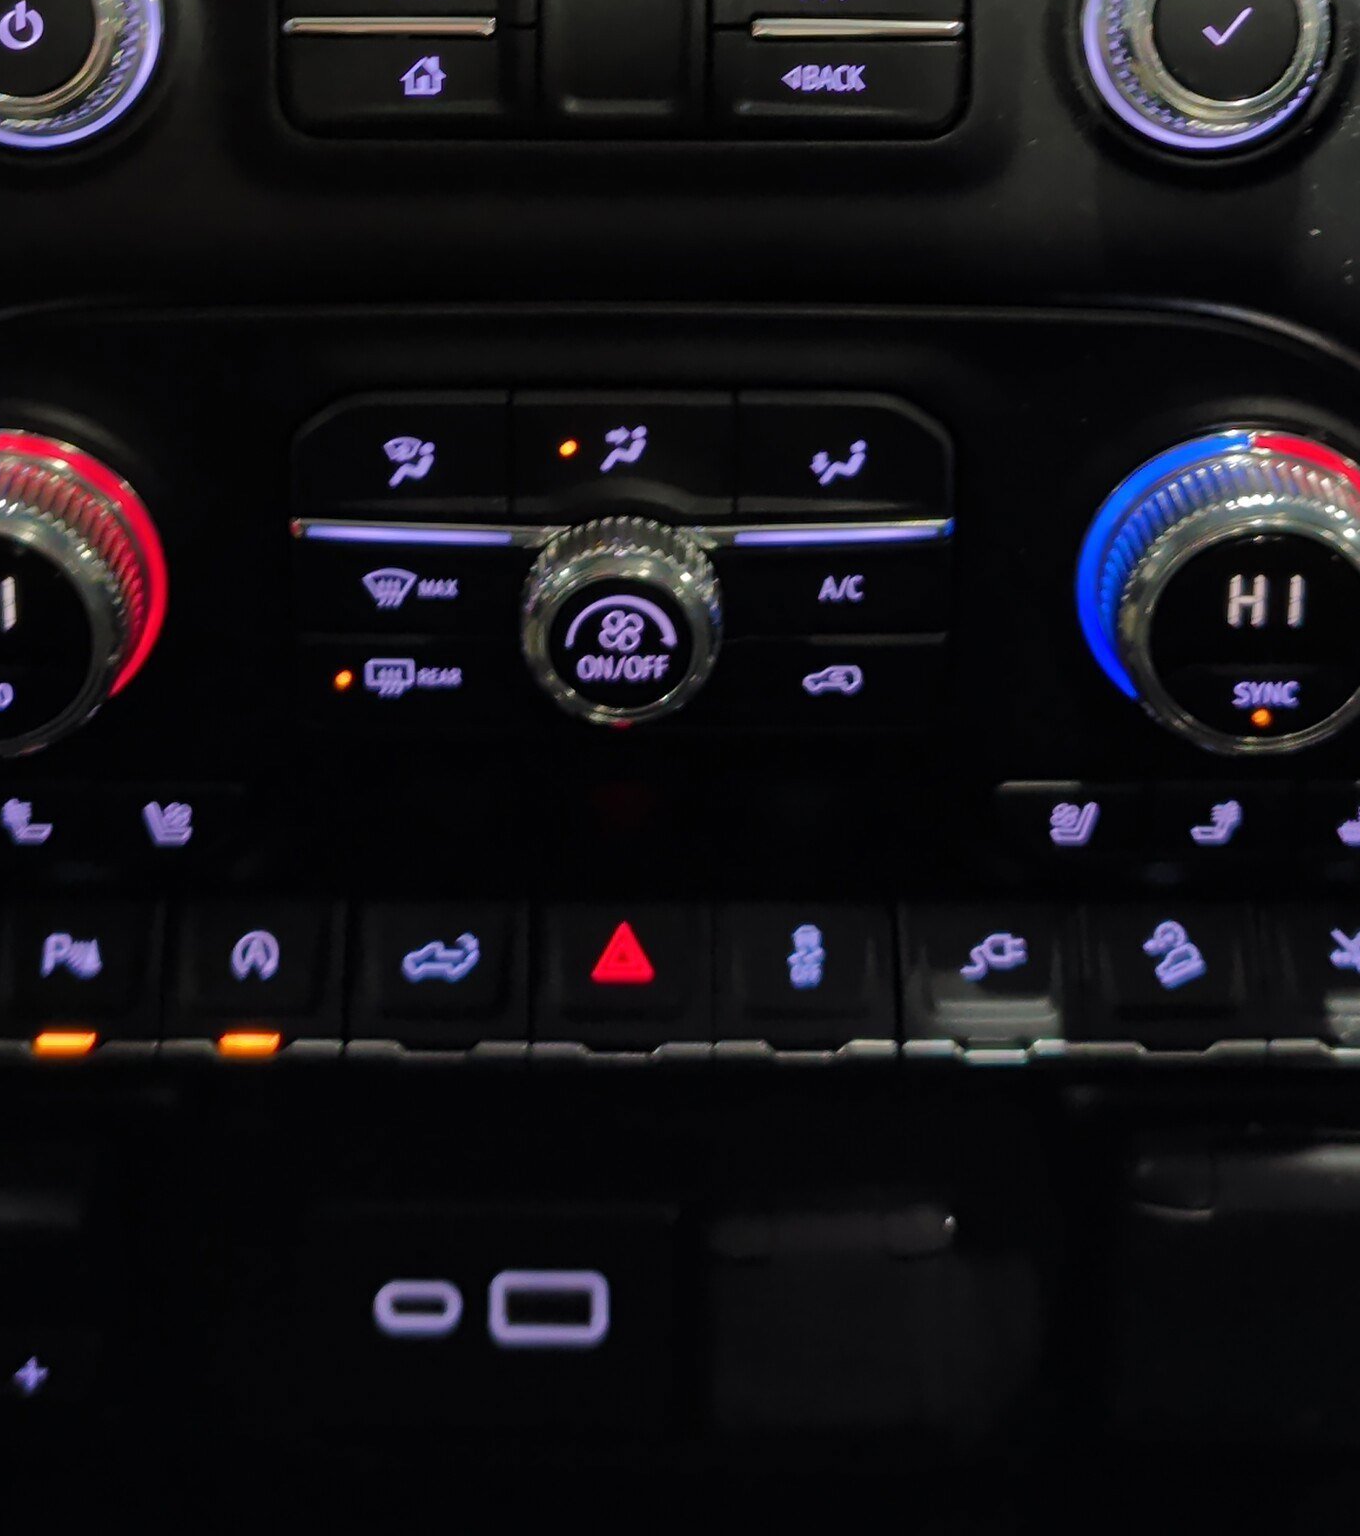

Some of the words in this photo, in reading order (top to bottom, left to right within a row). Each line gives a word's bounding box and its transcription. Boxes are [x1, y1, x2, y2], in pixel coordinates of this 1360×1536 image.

[802, 66, 866, 92] BACK
[819, 576, 863, 601] A/C
[1229, 576, 1304, 627] HI
[578, 655, 669, 682] ON/OFF
[1234, 682, 1299, 708] SYNC
